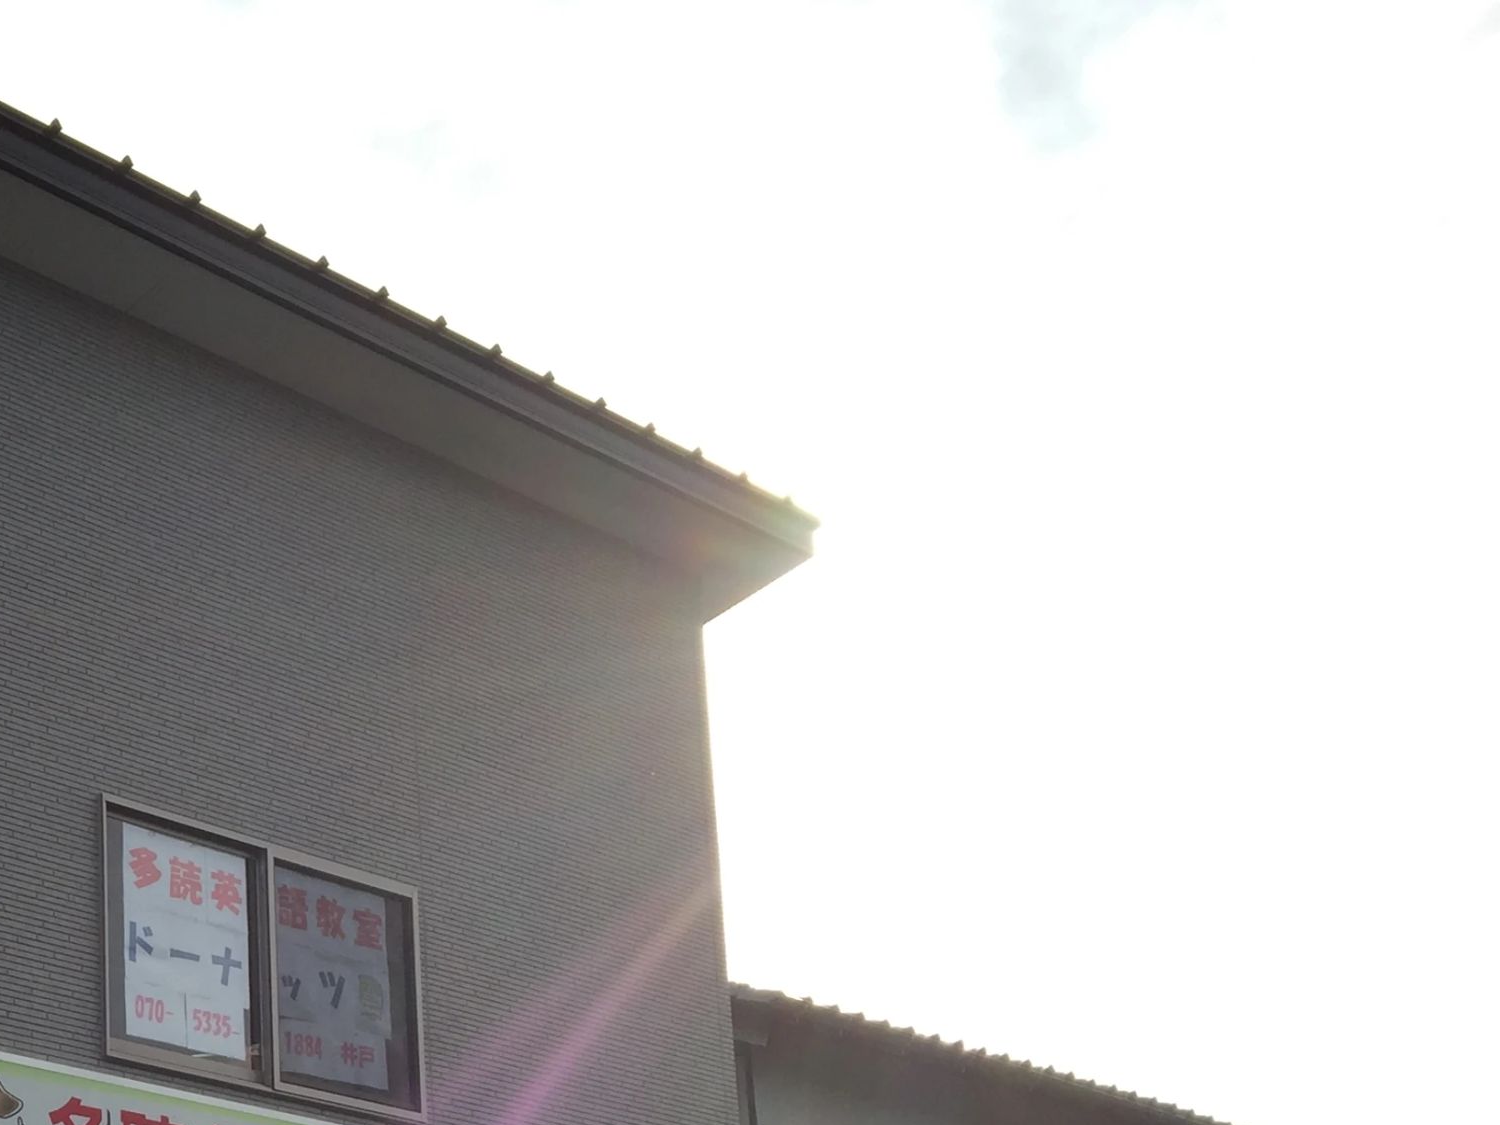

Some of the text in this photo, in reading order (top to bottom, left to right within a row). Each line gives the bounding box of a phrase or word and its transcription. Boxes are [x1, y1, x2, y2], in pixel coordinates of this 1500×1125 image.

[128, 847, 384, 951] 多読英 語教室
[128, 920, 243, 986] ドーナ
